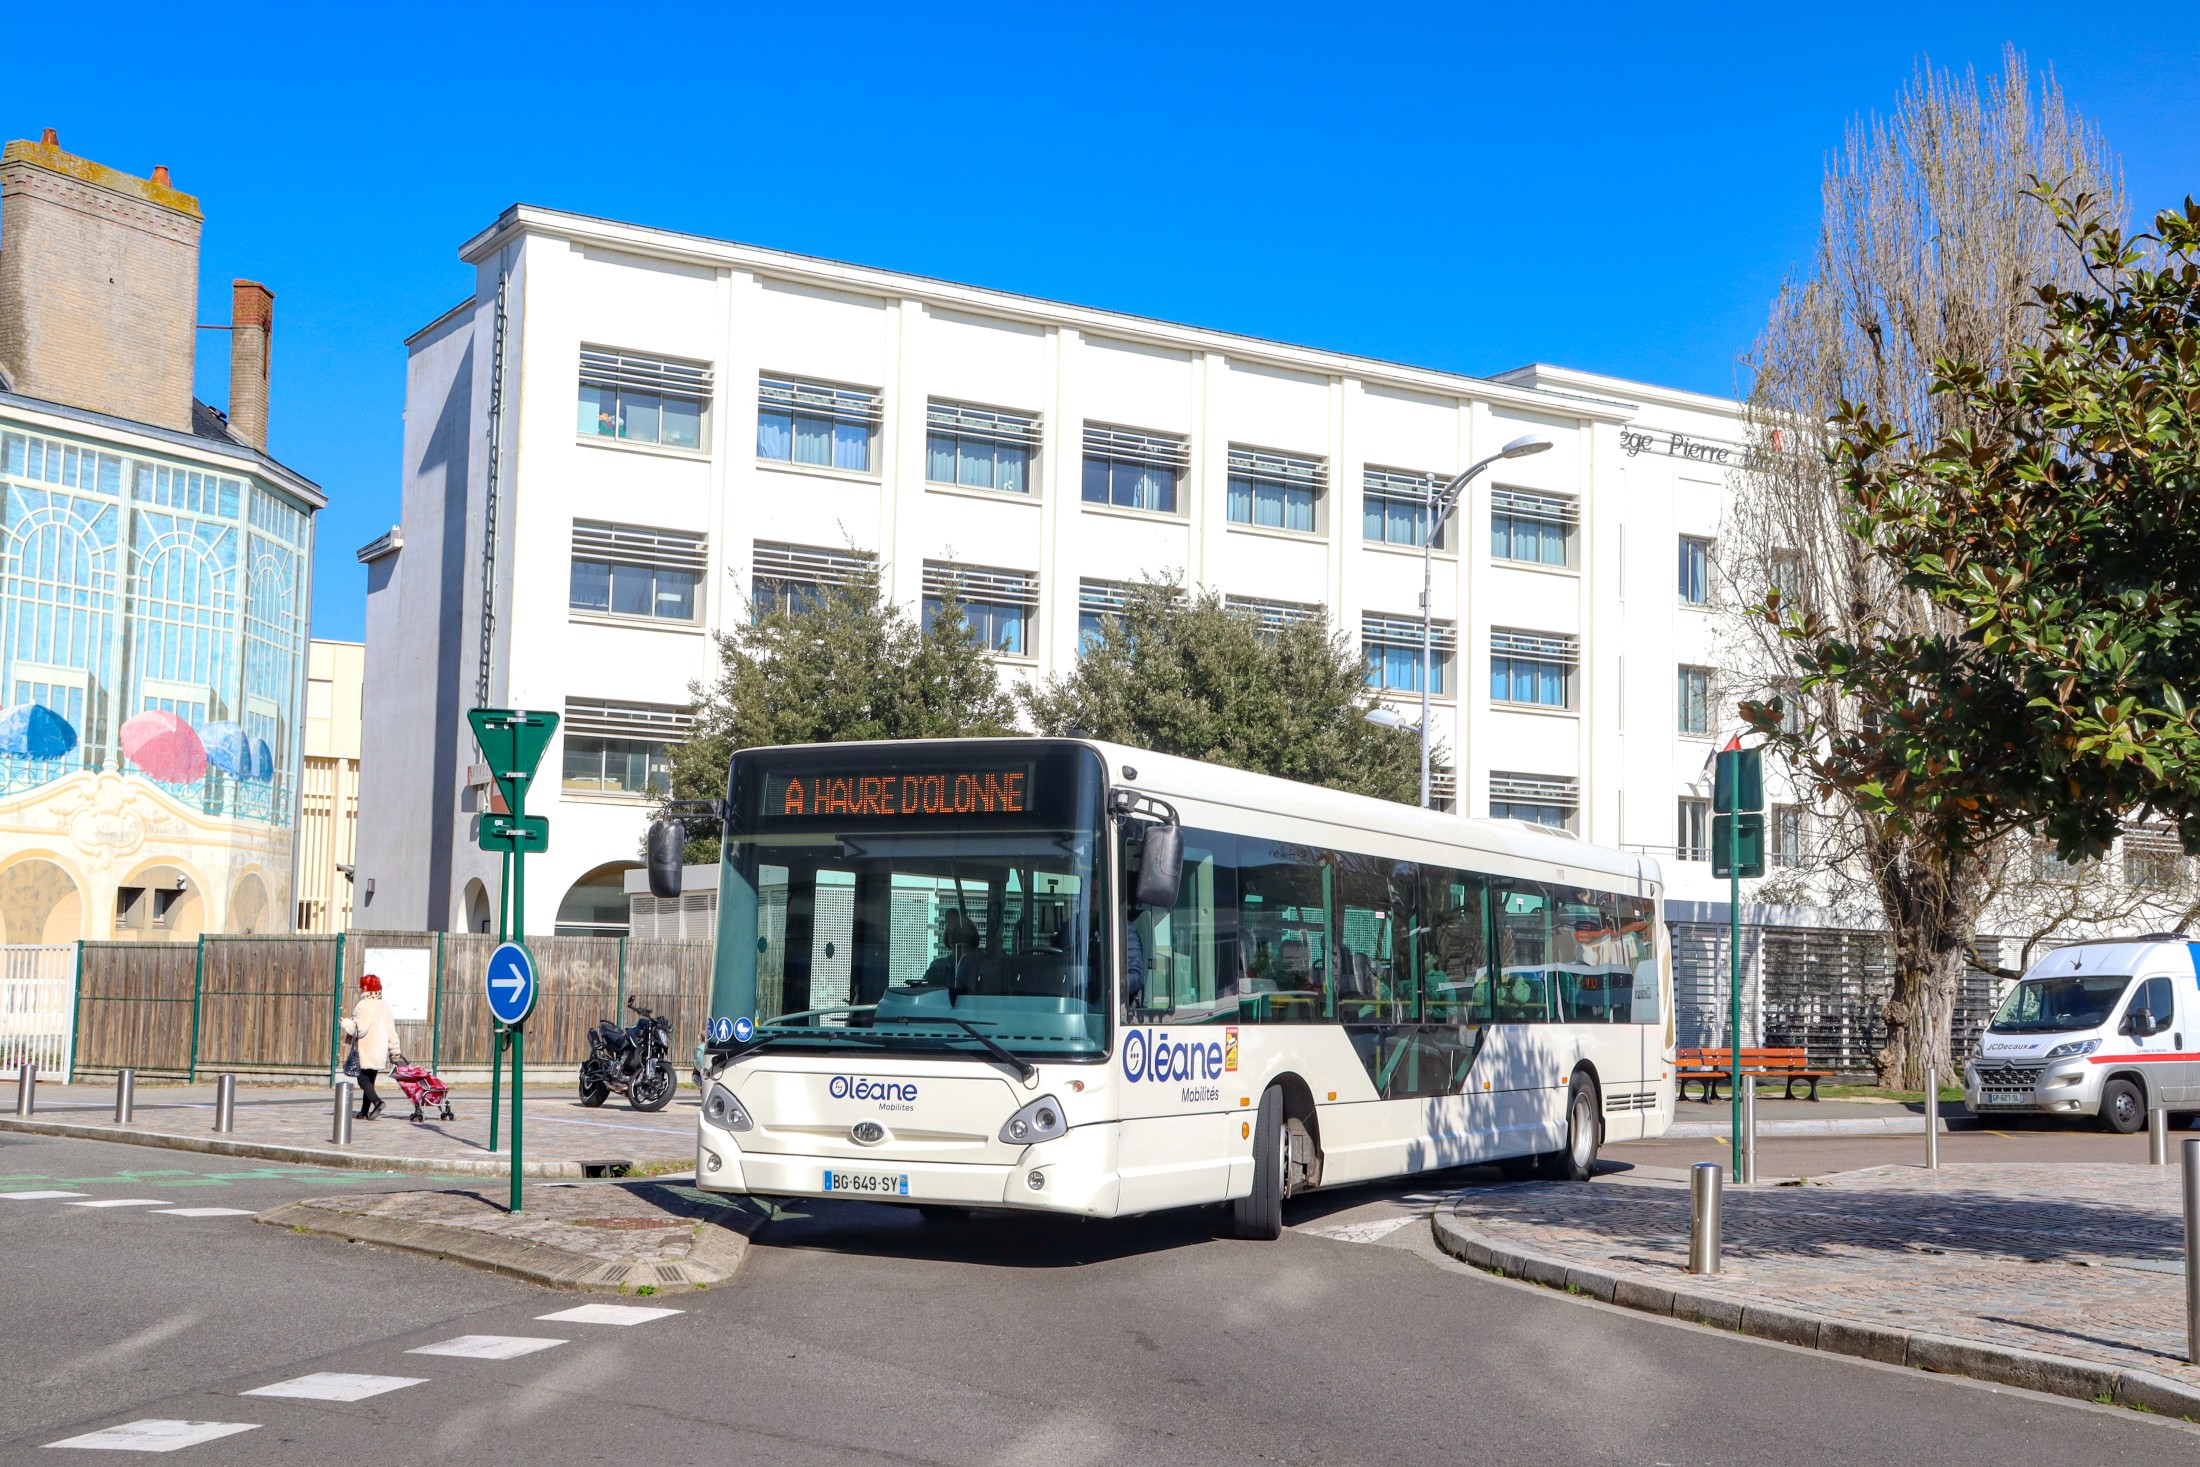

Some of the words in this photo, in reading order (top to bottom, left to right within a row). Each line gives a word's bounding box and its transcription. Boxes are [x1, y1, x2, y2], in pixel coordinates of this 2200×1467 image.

[491, 268, 508, 415] Mauger
[1668, 433, 1730, 464] Pierre
[784, 777, 804, 814] A
[814, 776, 896, 814] HAVRE
[901, 773, 1025, 814] D'OLONNE
[1986, 1043, 2029, 1051] JCDecaux
[1181, 1086, 1219, 1103] Mobilités
[833, 1174, 898, 1193] BG-649-SY
